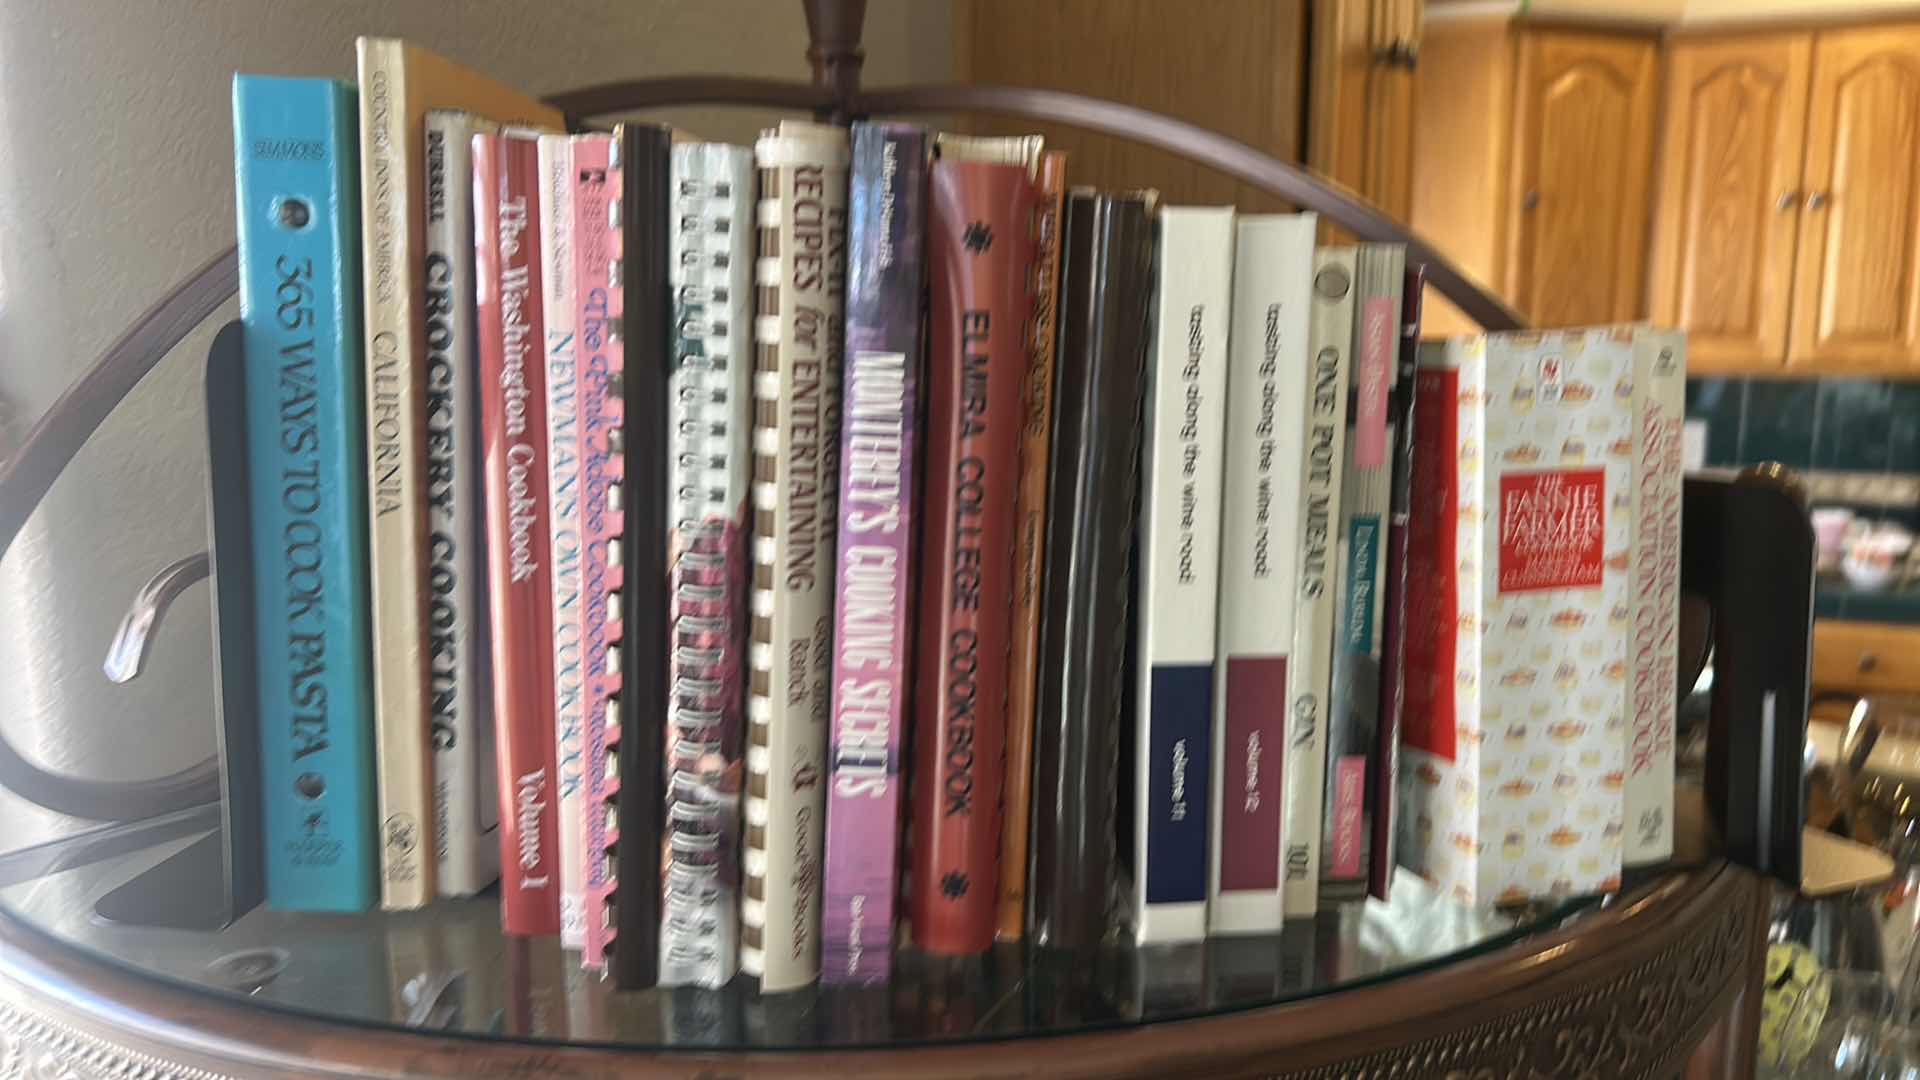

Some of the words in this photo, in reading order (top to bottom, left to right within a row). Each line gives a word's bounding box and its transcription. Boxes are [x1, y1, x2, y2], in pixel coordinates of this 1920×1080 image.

[498, 196, 529, 258] The
[275, 254, 314, 331] 365
[584, 287, 608, 352] The
[793, 304, 825, 353] for
[499, 264, 533, 437] Washington
[959, 309, 992, 440] ELMIRA
[1181, 304, 1205, 380] tasting
[1258, 303, 1283, 378] tasting
[278, 338, 320, 453] WAYS
[425, 251, 456, 520] CROCKERY
[1179, 383, 1204, 440] along
[1256, 380, 1282, 438] along
[1313, 345, 1340, 416] ONE
[372, 330, 402, 518] CALIFORNIA
[847, 350, 906, 531] MONTEREY'S
[1184, 443, 1203, 476] the
[1258, 440, 1278, 472] the
[1308, 423, 1336, 488] POT
[283, 461, 321, 513] TO
[506, 443, 538, 584] Cookbook
[787, 360, 822, 593] ENTERTAINING
[1181, 482, 1200, 528] wine
[1256, 477, 1276, 522] wine
[285, 521, 325, 622] COOK
[555, 529, 582, 611] OWN
[952, 457, 985, 614] COLLEGE
[1179, 532, 1199, 585] road
[1254, 526, 1273, 580] road
[1302, 492, 1330, 600] MEALS
[429, 530, 458, 753] COOKING
[841, 544, 898, 670] COOKING
[289, 631, 329, 761] PASTA
[557, 622, 586, 799] COOKBOOK
[945, 628, 978, 817] COOKBOOK
[835, 677, 894, 798] SECRETS
[1171, 737, 1189, 801] volume
[1244, 729, 1263, 792] volume
[515, 767, 546, 868] Volume
